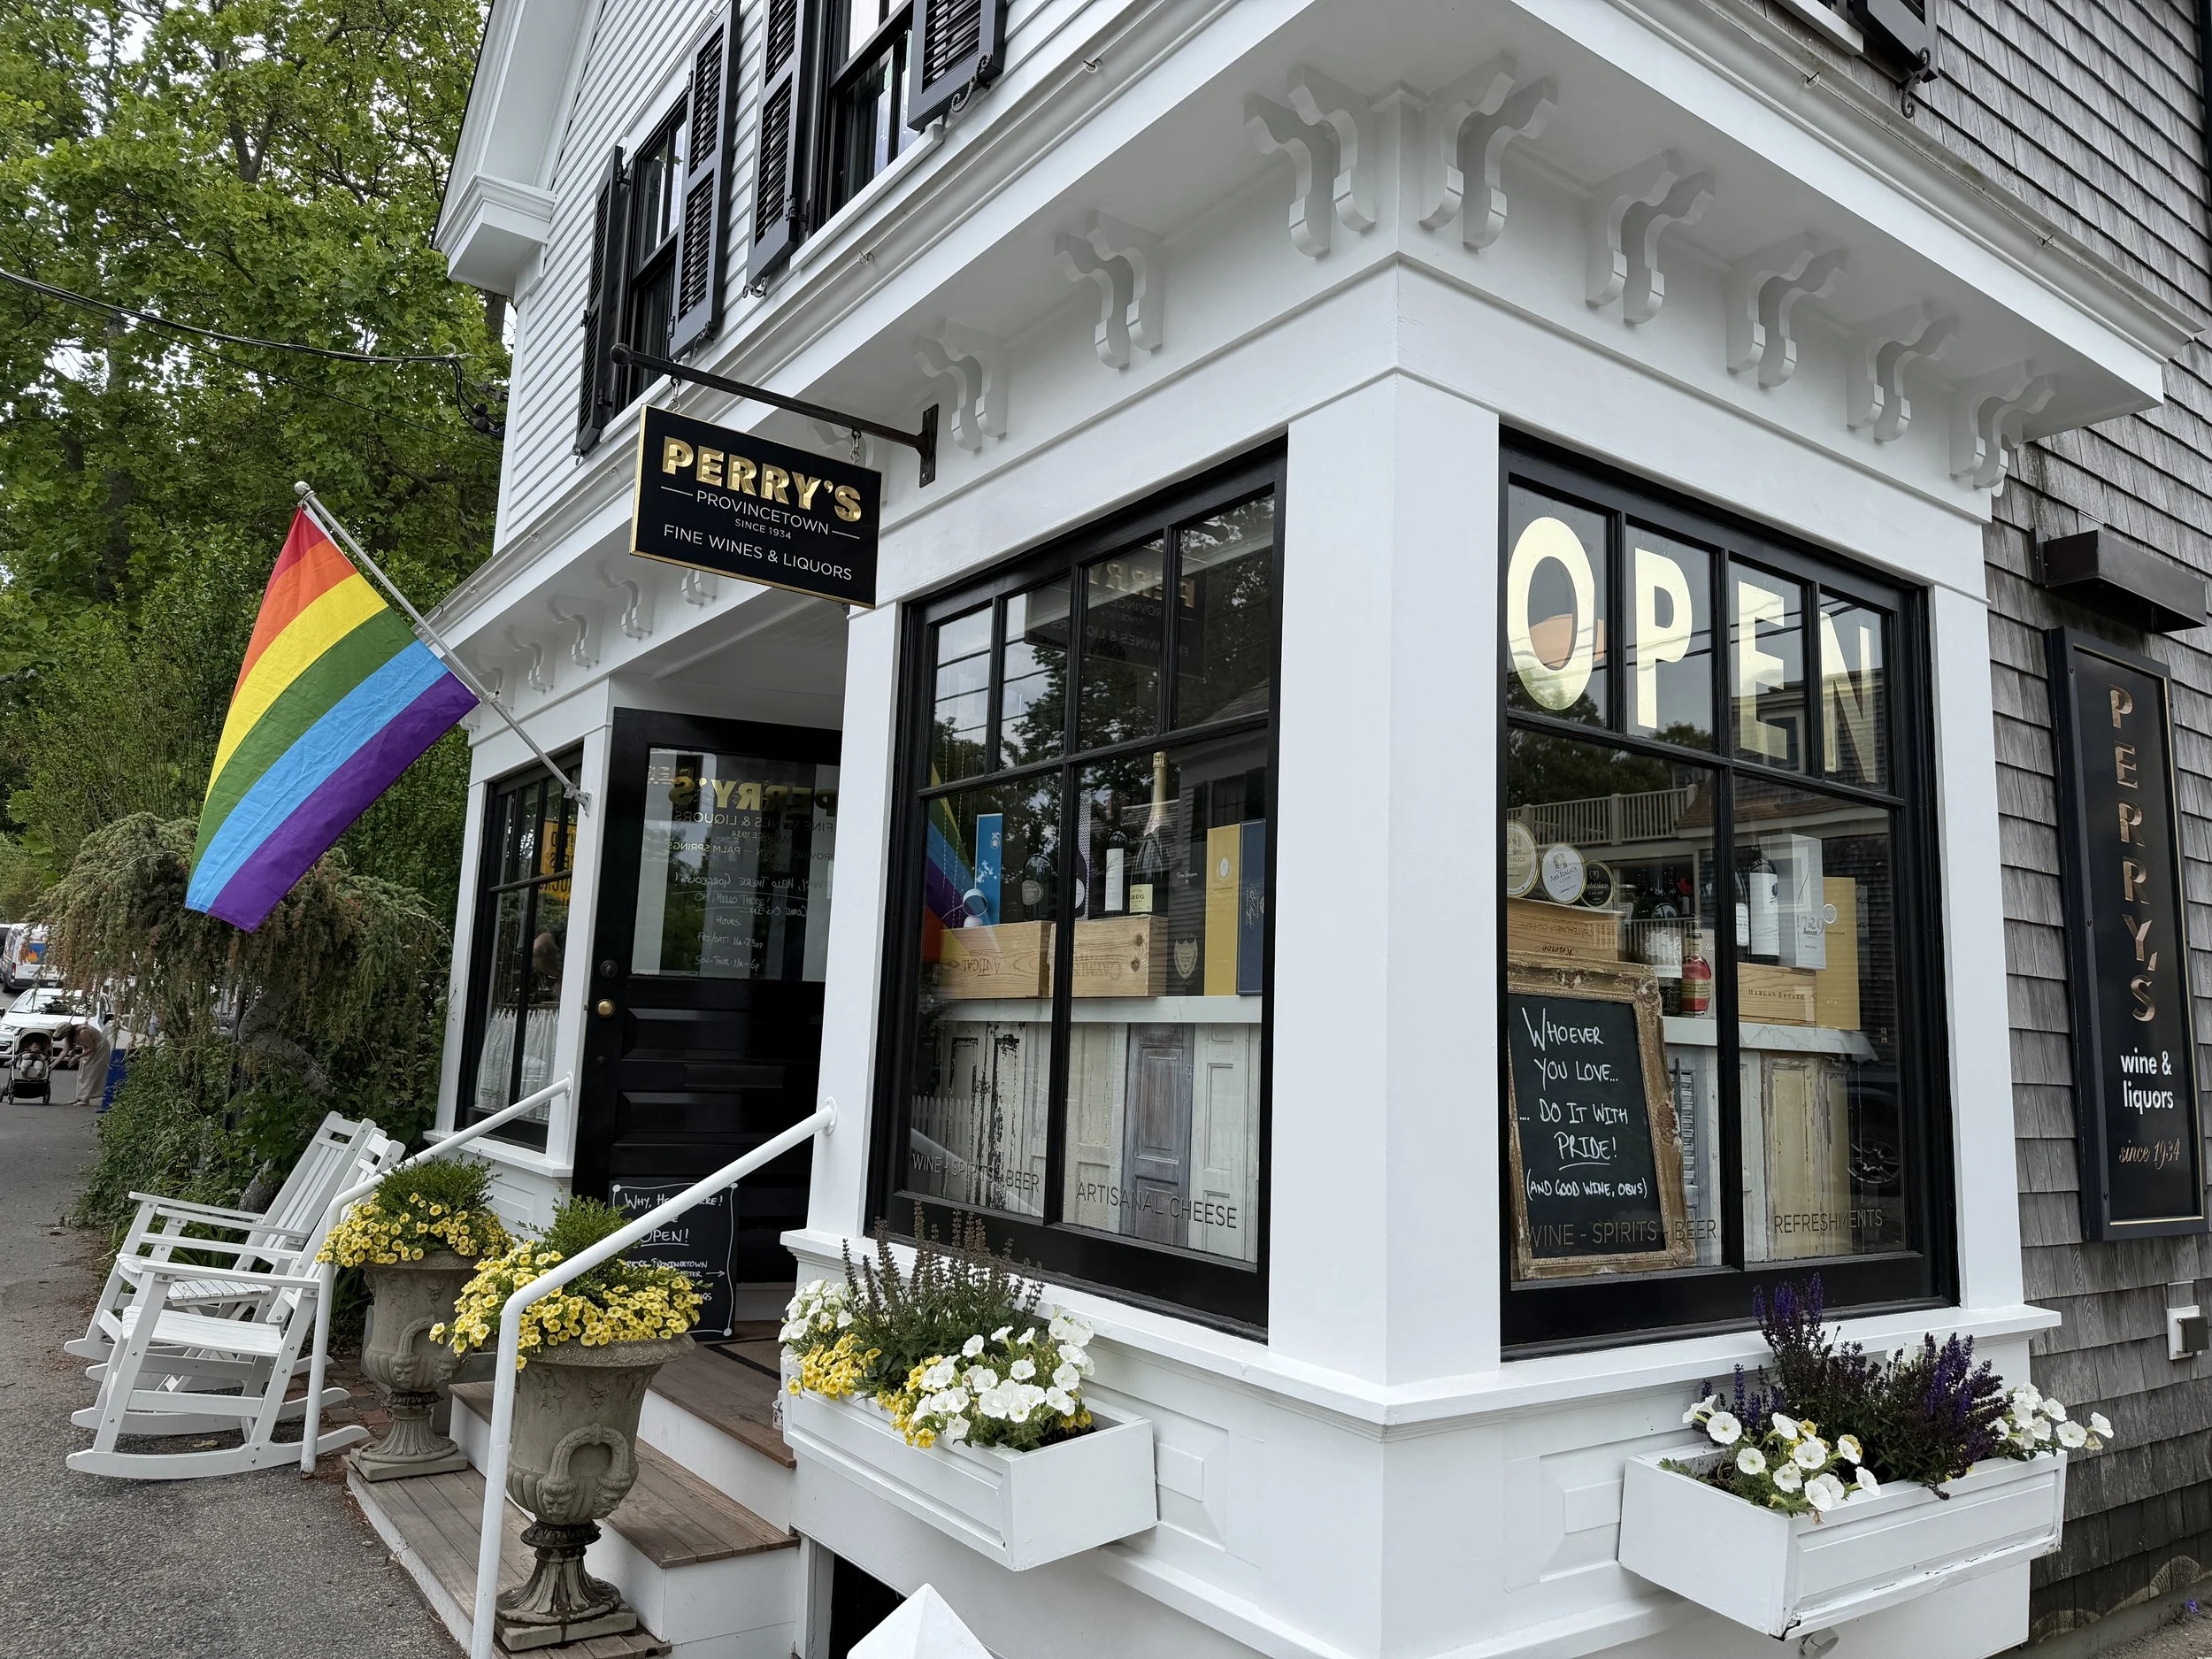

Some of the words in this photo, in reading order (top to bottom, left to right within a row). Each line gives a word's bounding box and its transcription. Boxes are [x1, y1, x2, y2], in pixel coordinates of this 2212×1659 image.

[662, 435, 862, 523] PERRY'S
[696, 489, 829, 535] PROVINCETOWN
[734, 518, 766, 534] SINCE
[768, 527, 792, 541] 1934
[664, 524, 703, 546] FINE
[708, 534, 763, 559] WINES
[767, 549, 779, 564] &
[783, 553, 853, 580] LIQUORS
[1507, 516, 1878, 784] OPEN
[2108, 682, 2158, 1023] PERRY'S
[1747, 988, 1776, 997] HARLAN
[1521, 1007, 1603, 1051] WHOEVER
[1534, 1058, 1567, 1090] YOU
[2120, 1047, 2157, 1075] wine
[2162, 1050, 2172, 1076] &
[1567, 1102, 1587, 1125] IT
[1593, 1103, 1628, 1125] WITH
[2124, 1079, 2174, 1115] liquors
[1554, 1132, 1617, 1161] PRIDE!
[2118, 1140, 2150, 1163] since
[2154, 1137, 2180, 1170] 1934
[912, 1153, 941, 1175] WINE
[951, 1159, 995, 1184] SPIRITS
[1006, 1170, 1040, 1194] BEER
[1526, 1168, 1552, 1201] (AND
[1555, 1181, 1579, 1197] GOOD
[1583, 1180, 1615, 1198] WINE,
[625, 1193, 651, 1210] WHY,
[1076, 1181, 1164, 1216] ARTISANAL
[1169, 1197, 1238, 1230] CHEESE
[1529, 1223, 1575, 1248] WINE
[1593, 1219, 1657, 1245] SPIRITS
[1675, 1218, 1717, 1240] BEER
[1773, 1208, 1883, 1234] REFRESHMENTS
